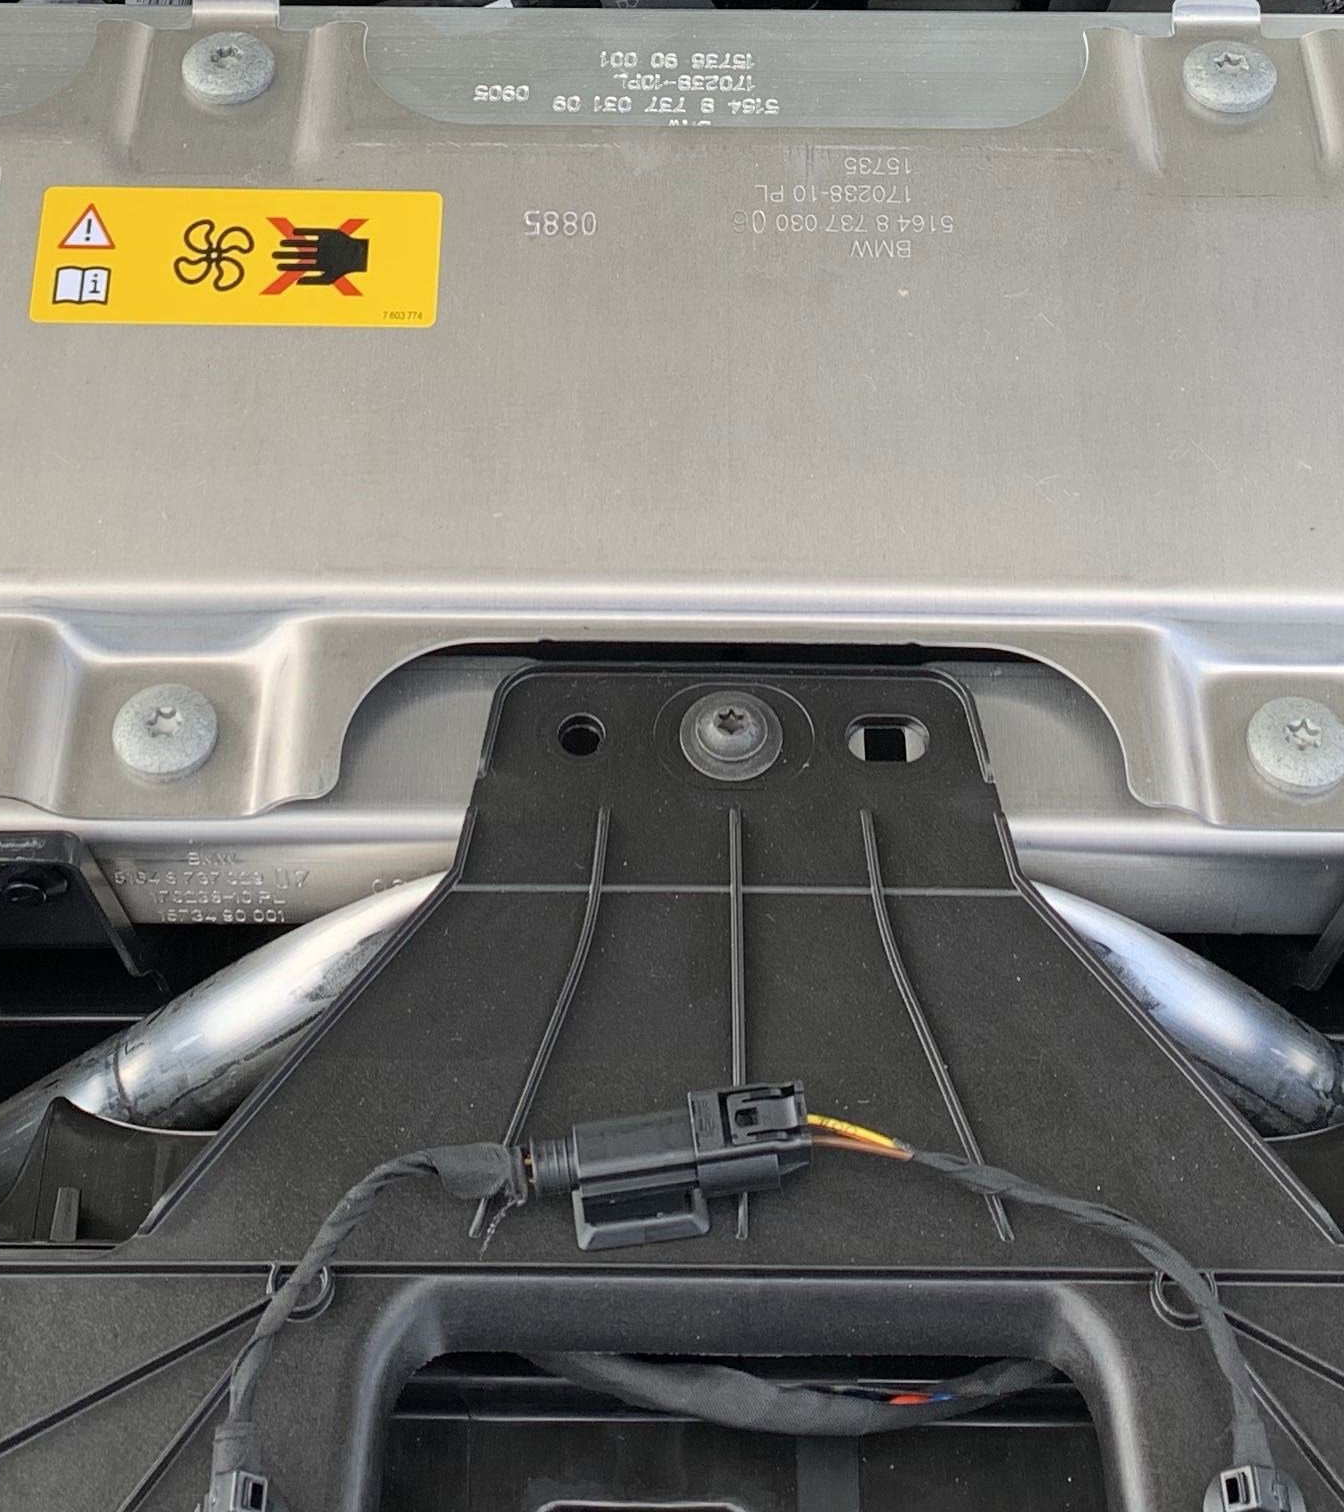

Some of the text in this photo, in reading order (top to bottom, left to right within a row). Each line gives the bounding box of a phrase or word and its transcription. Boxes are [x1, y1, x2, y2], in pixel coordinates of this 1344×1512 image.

[600, 51, 637, 68] 001
[650, 52, 678, 69] 90
[473, 85, 530, 103] 0905
[552, 95, 581, 112] 09
[593, 95, 632, 113] 031
[644, 96, 687, 113] 737
[844, 156, 912, 175] 15735
[755, 184, 912, 203] 170238-10 PL
[523, 210, 597, 236] 0885
[775, 214, 818, 233] 030
[824, 214, 868, 232] 737
[876, 214, 890, 232] 8
[897, 214, 954, 233] 5164
[849, 239, 912, 259] BMW
[253, 909, 286, 923] 001
